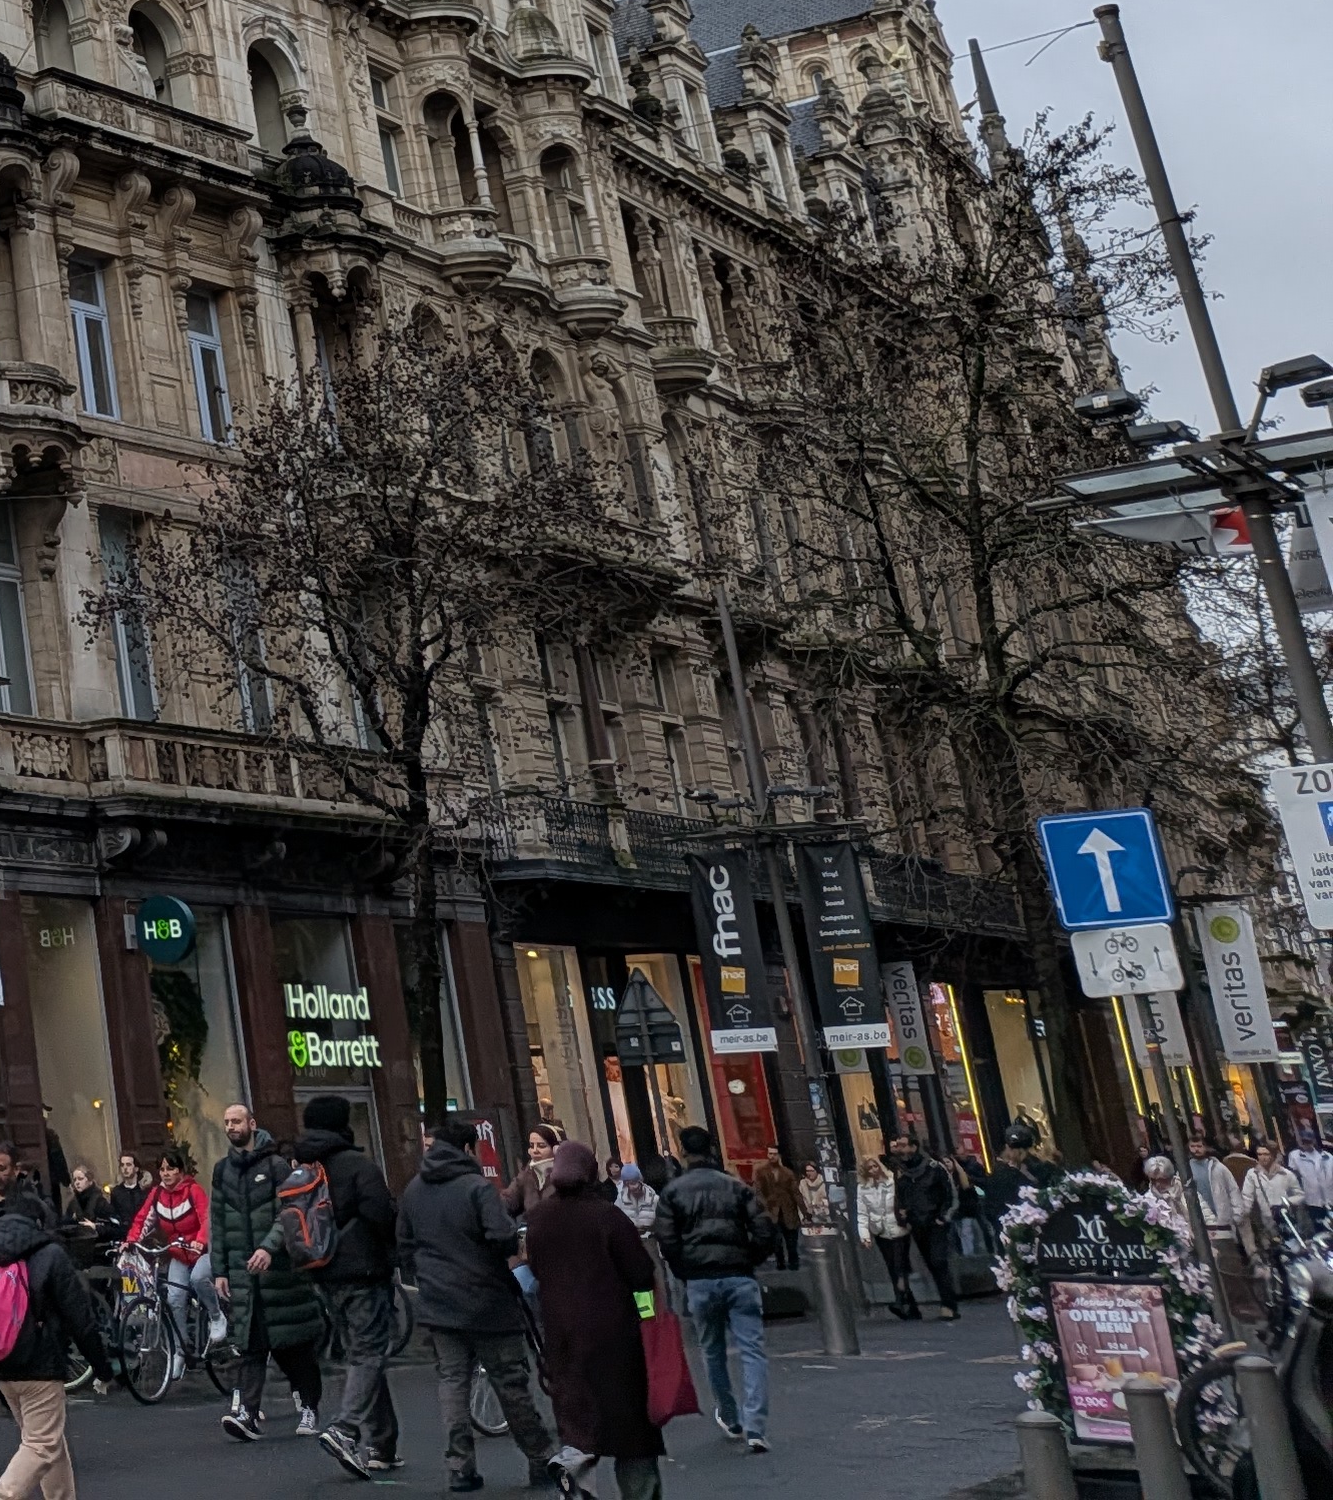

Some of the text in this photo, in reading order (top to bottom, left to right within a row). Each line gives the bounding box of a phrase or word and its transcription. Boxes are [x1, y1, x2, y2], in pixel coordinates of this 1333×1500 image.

[1292, 769, 1333, 795] ZO
[709, 864, 742, 959] fnac
[820, 914, 854, 922] Computers
[819, 928, 861, 937] Smartphones
[834, 962, 859, 972] fnac
[721, 970, 745, 980] fnac
[283, 983, 371, 1020] Holland
[891, 966, 917, 1039] veritas
[1222, 951, 1256, 1041] veritas
[720, 1033, 768, 1045] meir-as.be
[829, 1029, 887, 1044] meir-as.be
[1041, 1242, 1154, 1260] MARY CAKE
[1068, 1258, 1131, 1268] COFFEE
[1068, 1309, 1150, 1323] ONTBIJT
[1095, 1322, 1133, 1333] MENU
